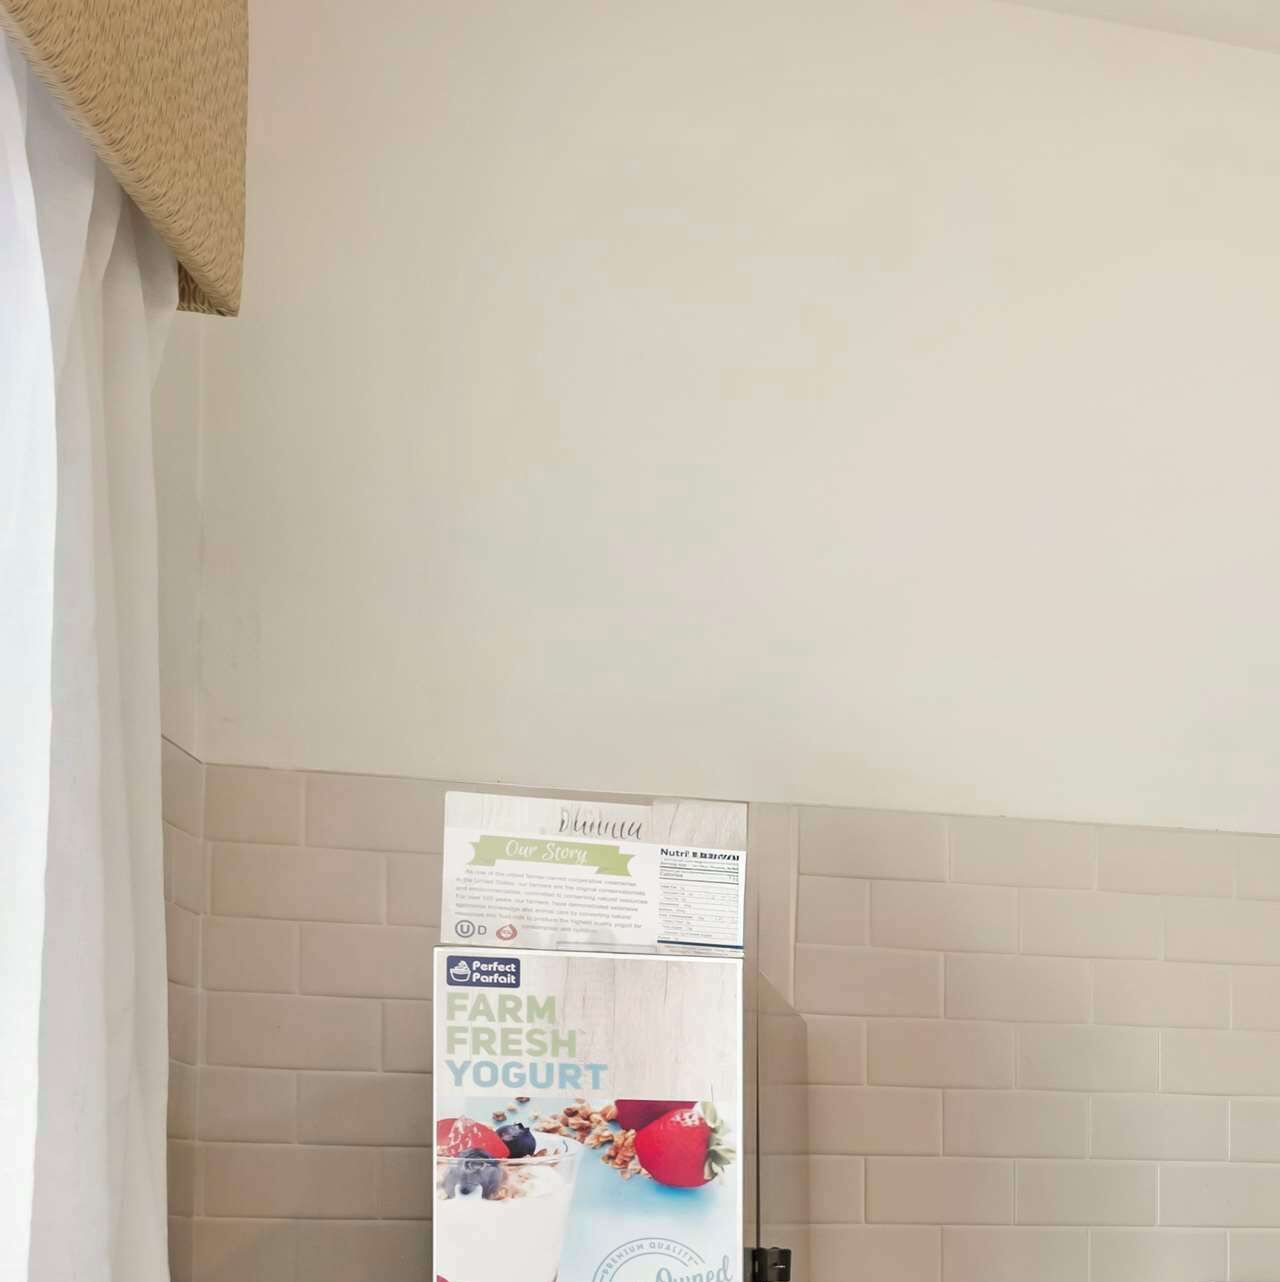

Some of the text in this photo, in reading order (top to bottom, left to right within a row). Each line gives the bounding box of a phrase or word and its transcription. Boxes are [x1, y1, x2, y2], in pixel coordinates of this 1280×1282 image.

[504, 839, 588, 863] Our Story
[472, 960, 517, 973] Perfect
[472, 973, 517, 985] Parfait
[446, 992, 557, 1025] FARM
[446, 1025, 577, 1058] FRESH
[445, 1060, 609, 1090] YOGURT
